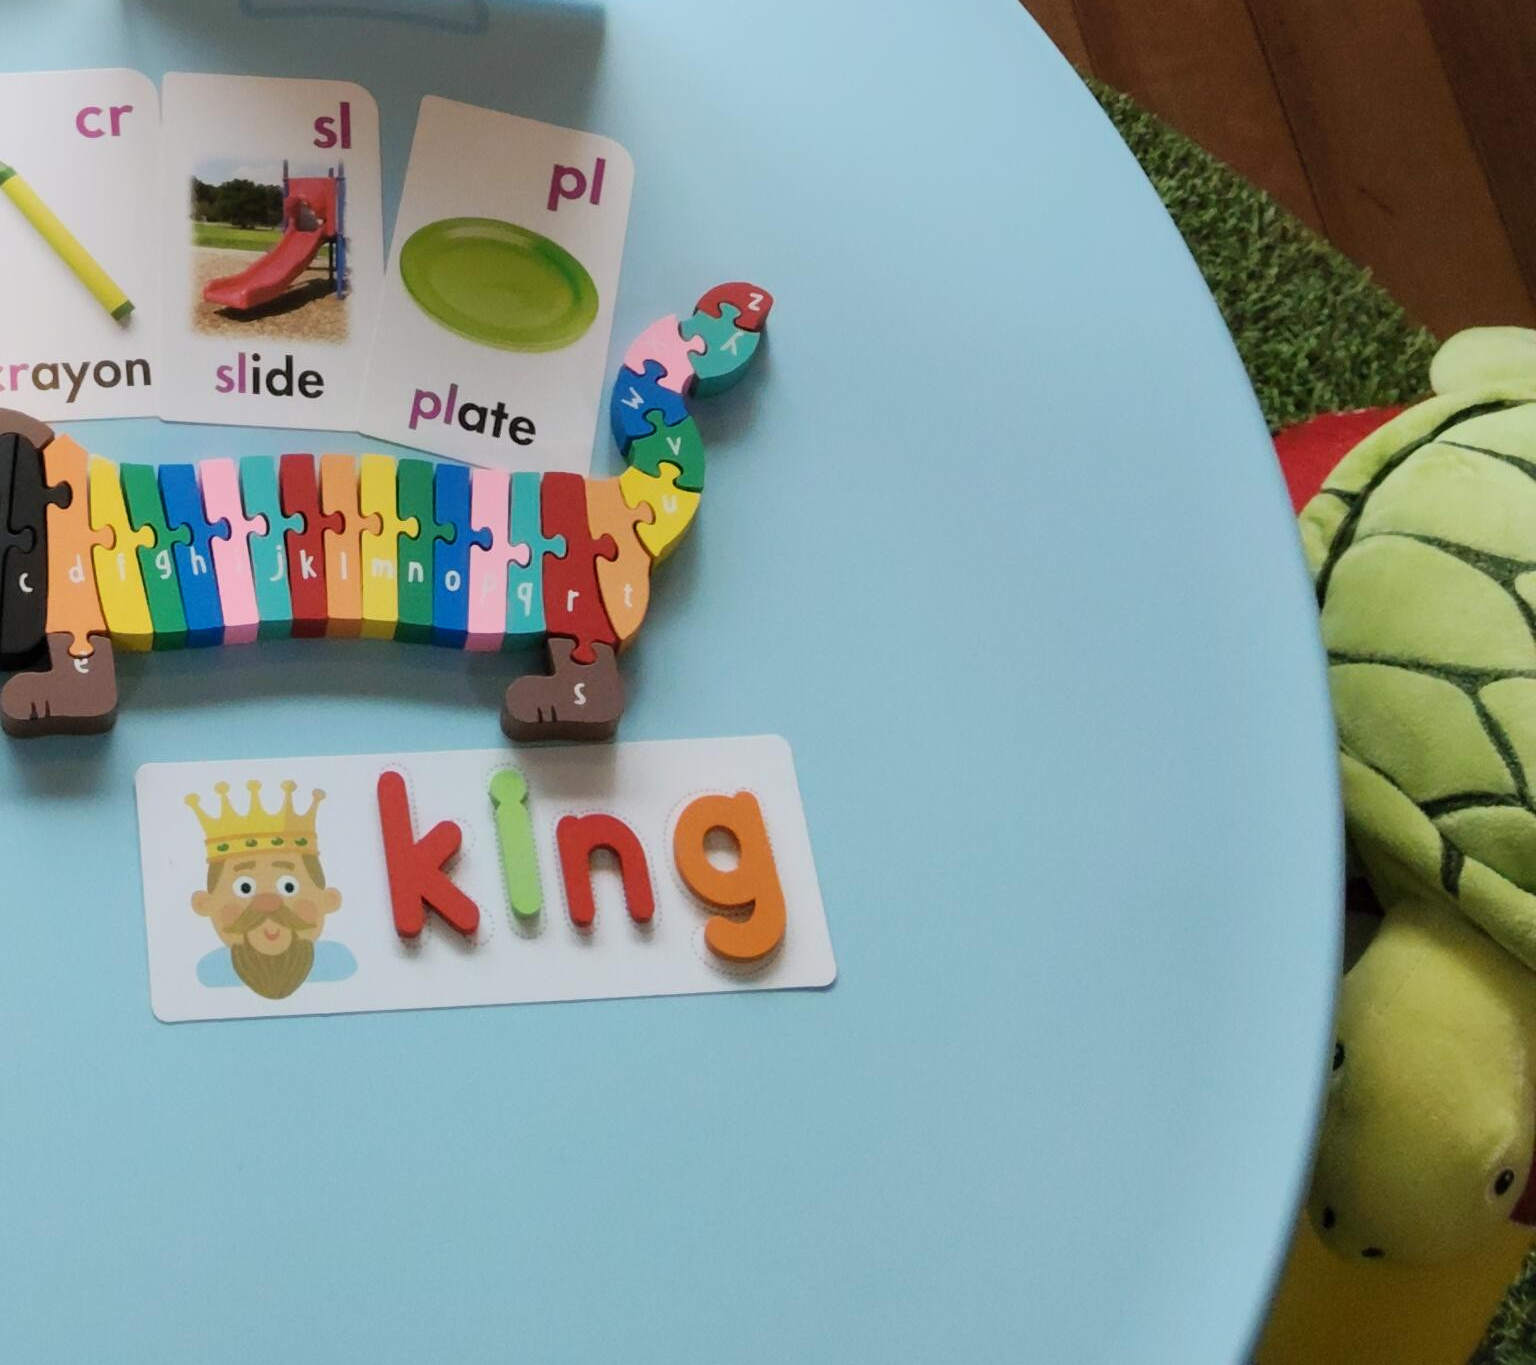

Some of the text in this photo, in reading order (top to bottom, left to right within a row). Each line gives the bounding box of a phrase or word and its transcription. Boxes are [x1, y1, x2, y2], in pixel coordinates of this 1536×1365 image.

[75, 100, 134, 140] cr
[312, 101, 353, 151] sl
[547, 158, 607, 212] pl
[747, 292, 764, 312] z
[721, 331, 745, 356] y
[214, 352, 326, 401] slide
[620, 386, 646, 410] w
[409, 383, 539, 448] plate
[667, 437, 682, 456] v
[661, 493, 678, 514] u
[68, 553, 85, 584] d
[116, 551, 127, 582] f
[154, 549, 172, 580] g
[190, 546, 207, 576] h
[269, 544, 284, 582] j
[300, 548, 317, 580] k
[339, 551, 348, 580] l
[371, 556, 395, 579] m
[407, 558, 425, 583] n
[19, 572, 34, 593] c
[444, 569, 461, 592] o
[517, 582, 534, 616] q
[567, 589, 580, 612] r
[623, 583, 634, 608] t
[573, 682, 587, 706] s
[376, 769, 787, 961] king
